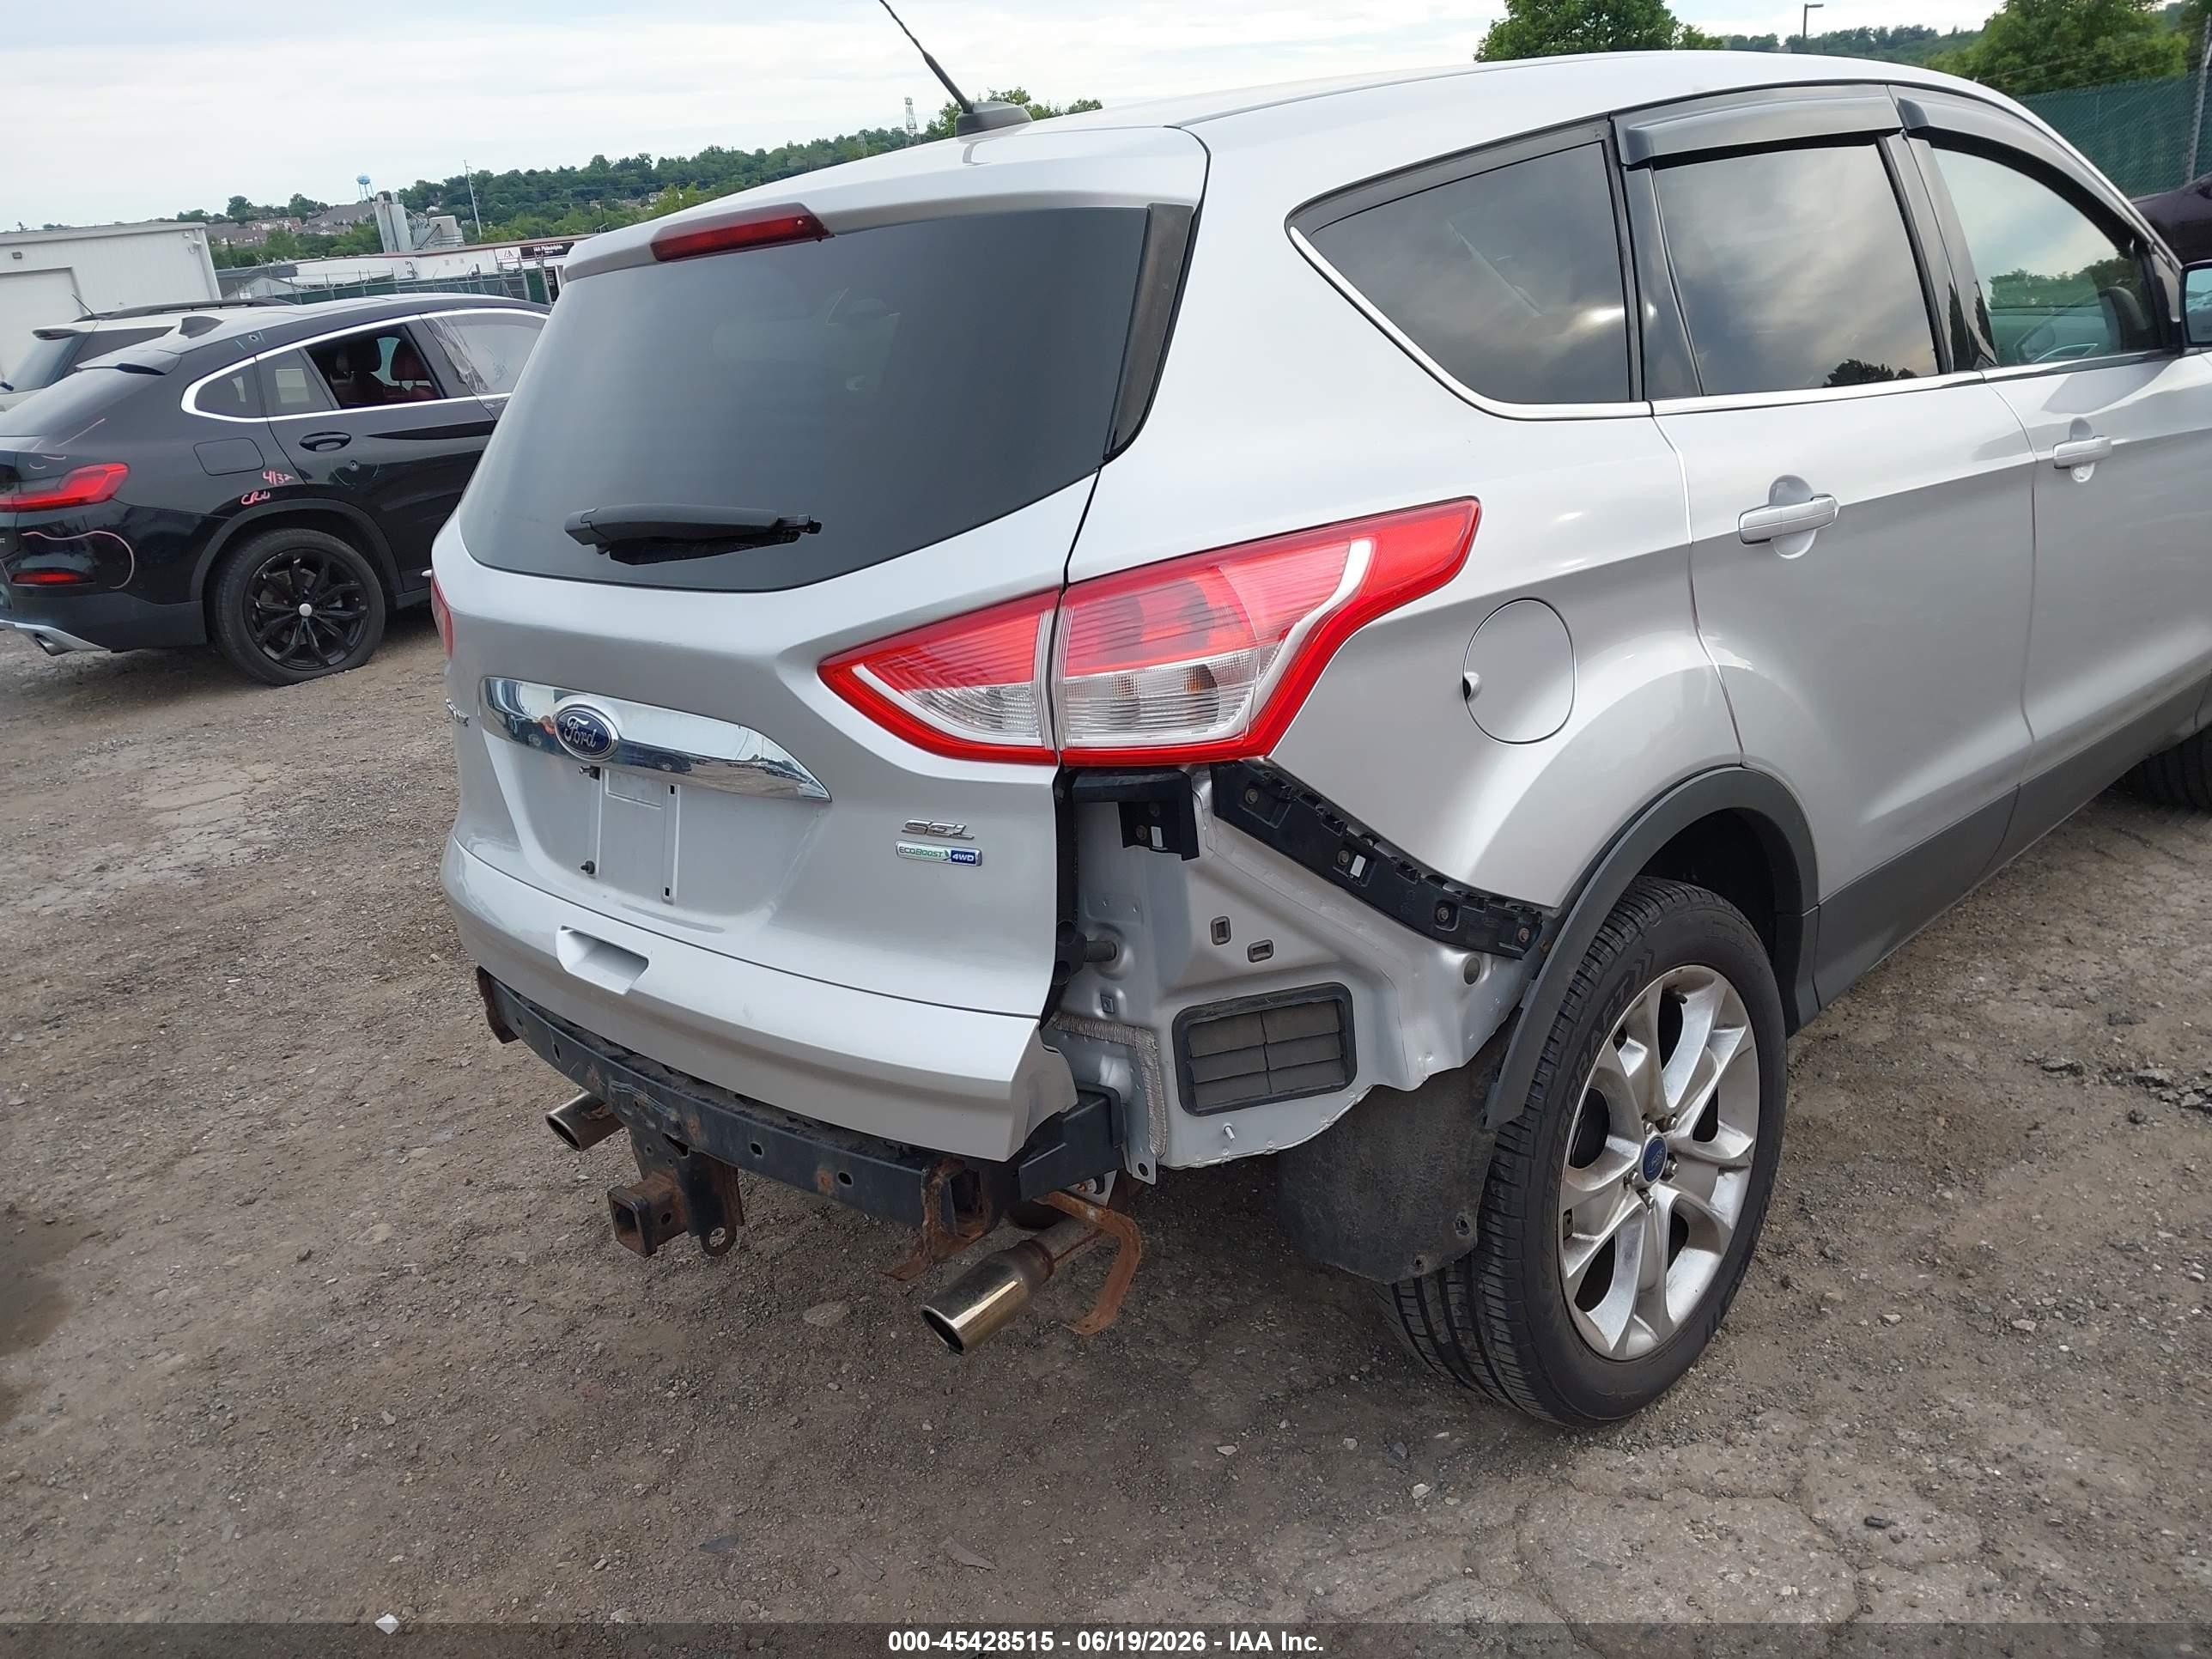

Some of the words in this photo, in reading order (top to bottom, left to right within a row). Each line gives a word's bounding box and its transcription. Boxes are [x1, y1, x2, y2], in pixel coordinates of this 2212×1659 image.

[564, 715, 599, 748] Ford
[901, 819, 975, 840] SEL
[952, 853, 975, 863] 4WD
